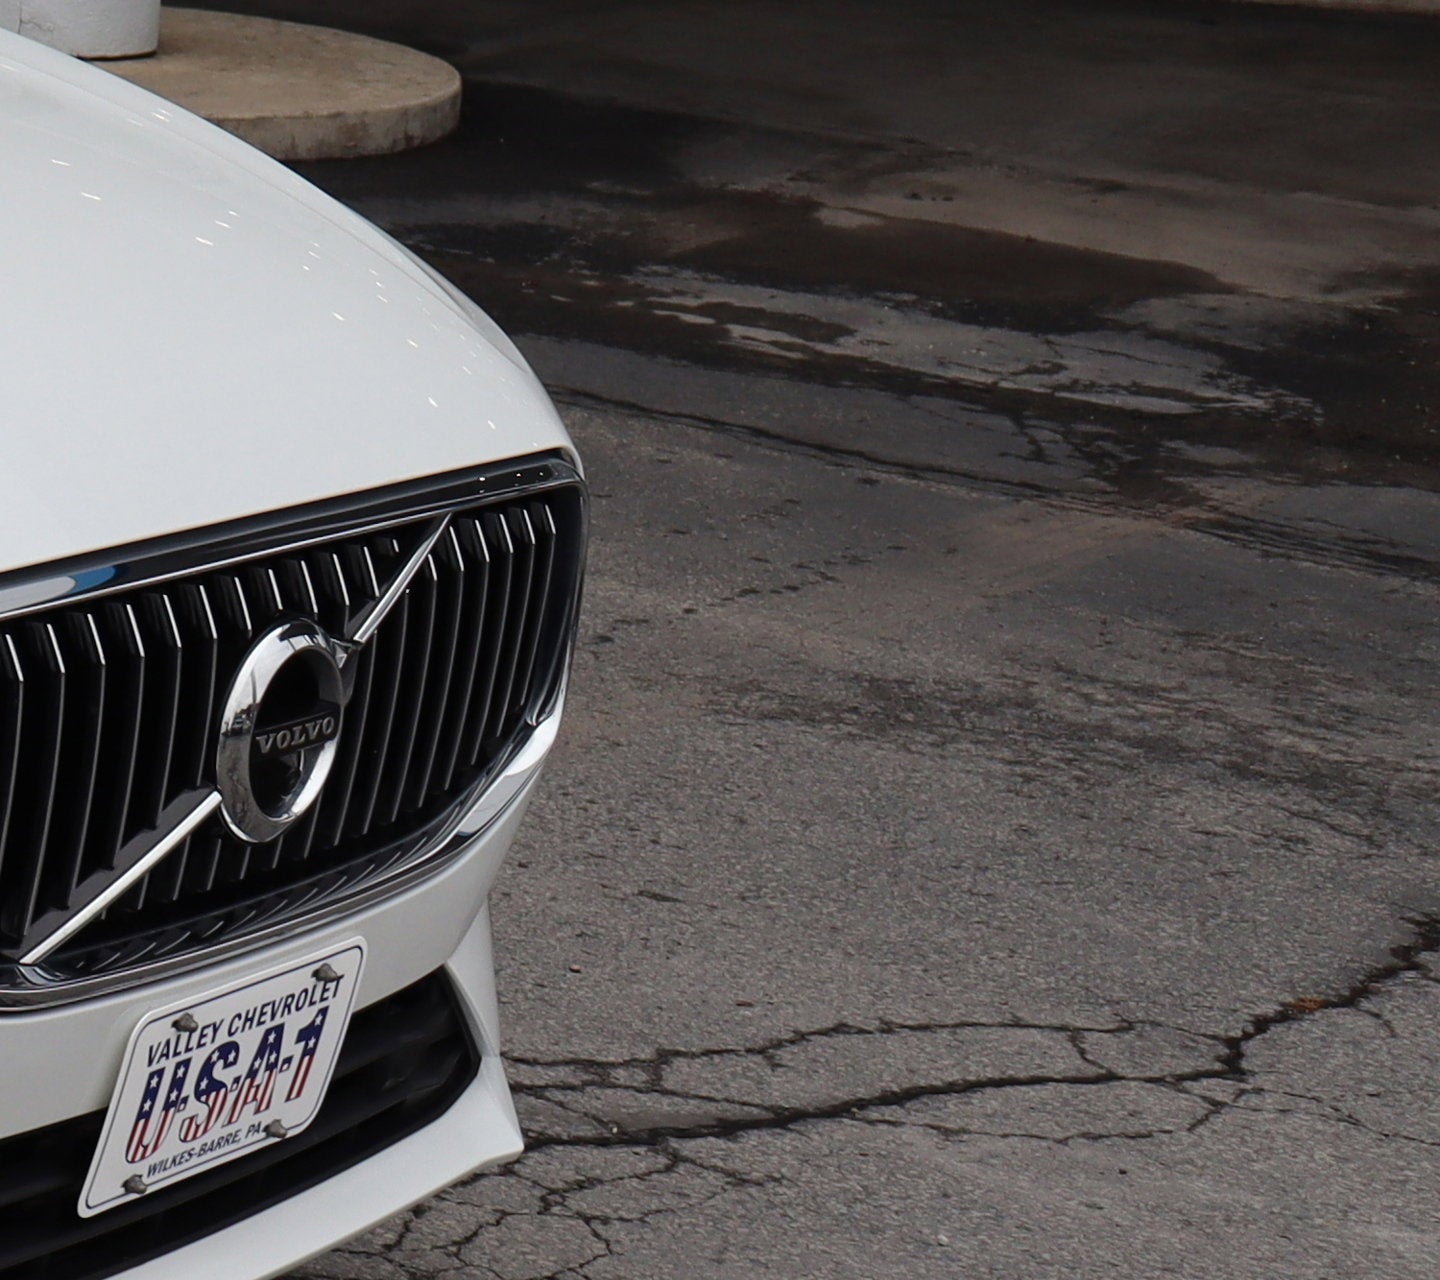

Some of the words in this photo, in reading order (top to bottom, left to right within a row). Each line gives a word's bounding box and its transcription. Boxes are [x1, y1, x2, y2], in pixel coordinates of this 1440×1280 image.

[256, 716, 335, 754] VOLVO
[147, 1020, 223, 1068] VALLEY
[227, 977, 343, 1036] CHEVROLET
[146, 1134, 243, 1179] WILKES-BARRE,
[244, 1120, 263, 1139] PA
